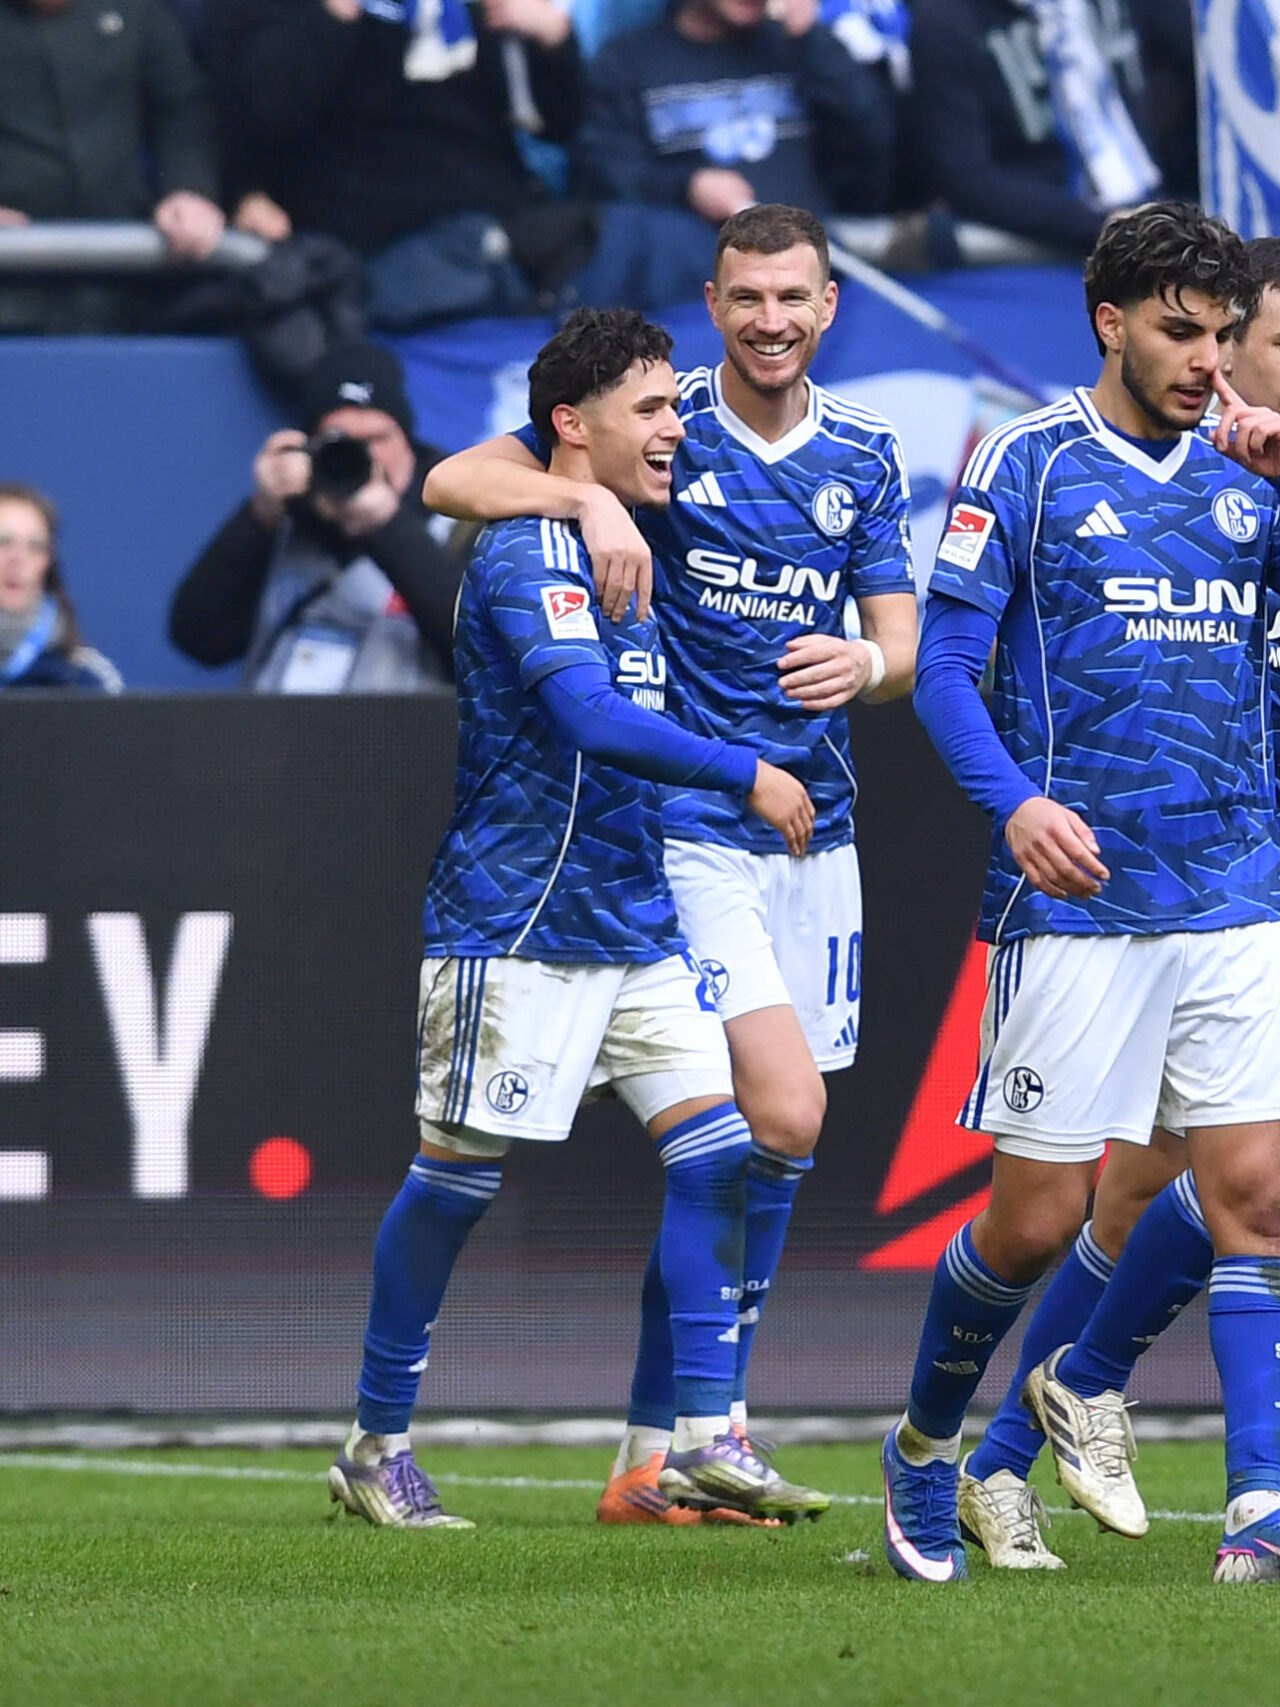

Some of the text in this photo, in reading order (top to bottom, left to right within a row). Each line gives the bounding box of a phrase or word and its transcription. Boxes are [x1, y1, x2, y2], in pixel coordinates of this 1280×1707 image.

[685, 548, 840, 601] SUN
[698, 587, 815, 626] MINIMEAL
[1103, 577, 1257, 616] SUN
[1125, 618, 1239, 643] MINIMEAL
[826, 930, 862, 1006] 10
